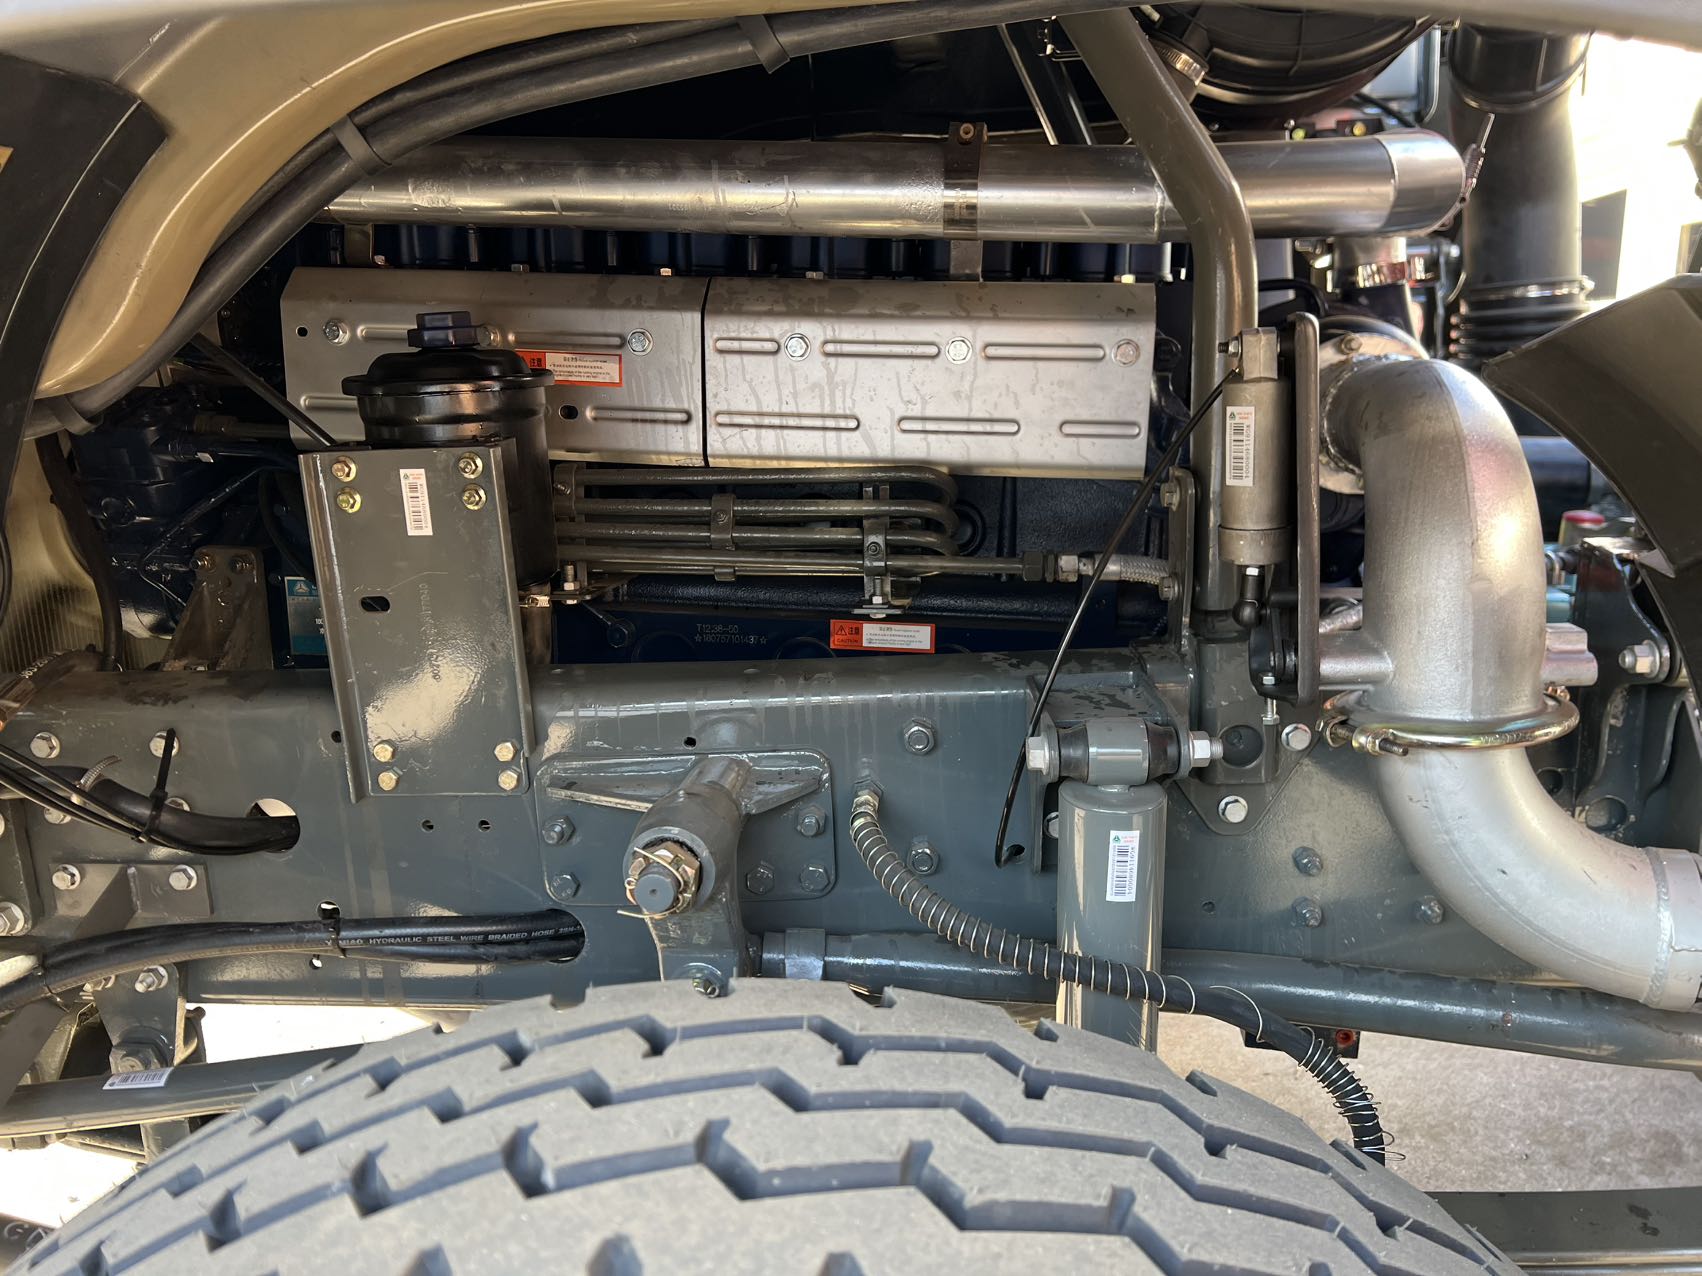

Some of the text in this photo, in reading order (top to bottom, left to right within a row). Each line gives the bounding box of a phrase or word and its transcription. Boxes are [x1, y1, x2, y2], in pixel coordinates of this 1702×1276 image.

[369, 936, 422, 944] HYDRAULIC
[427, 935, 456, 943] STEEL
[460, 934, 484, 942] WIRE
[488, 932, 528, 941] BRAIDED
[531, 929, 555, 938] HOSE
